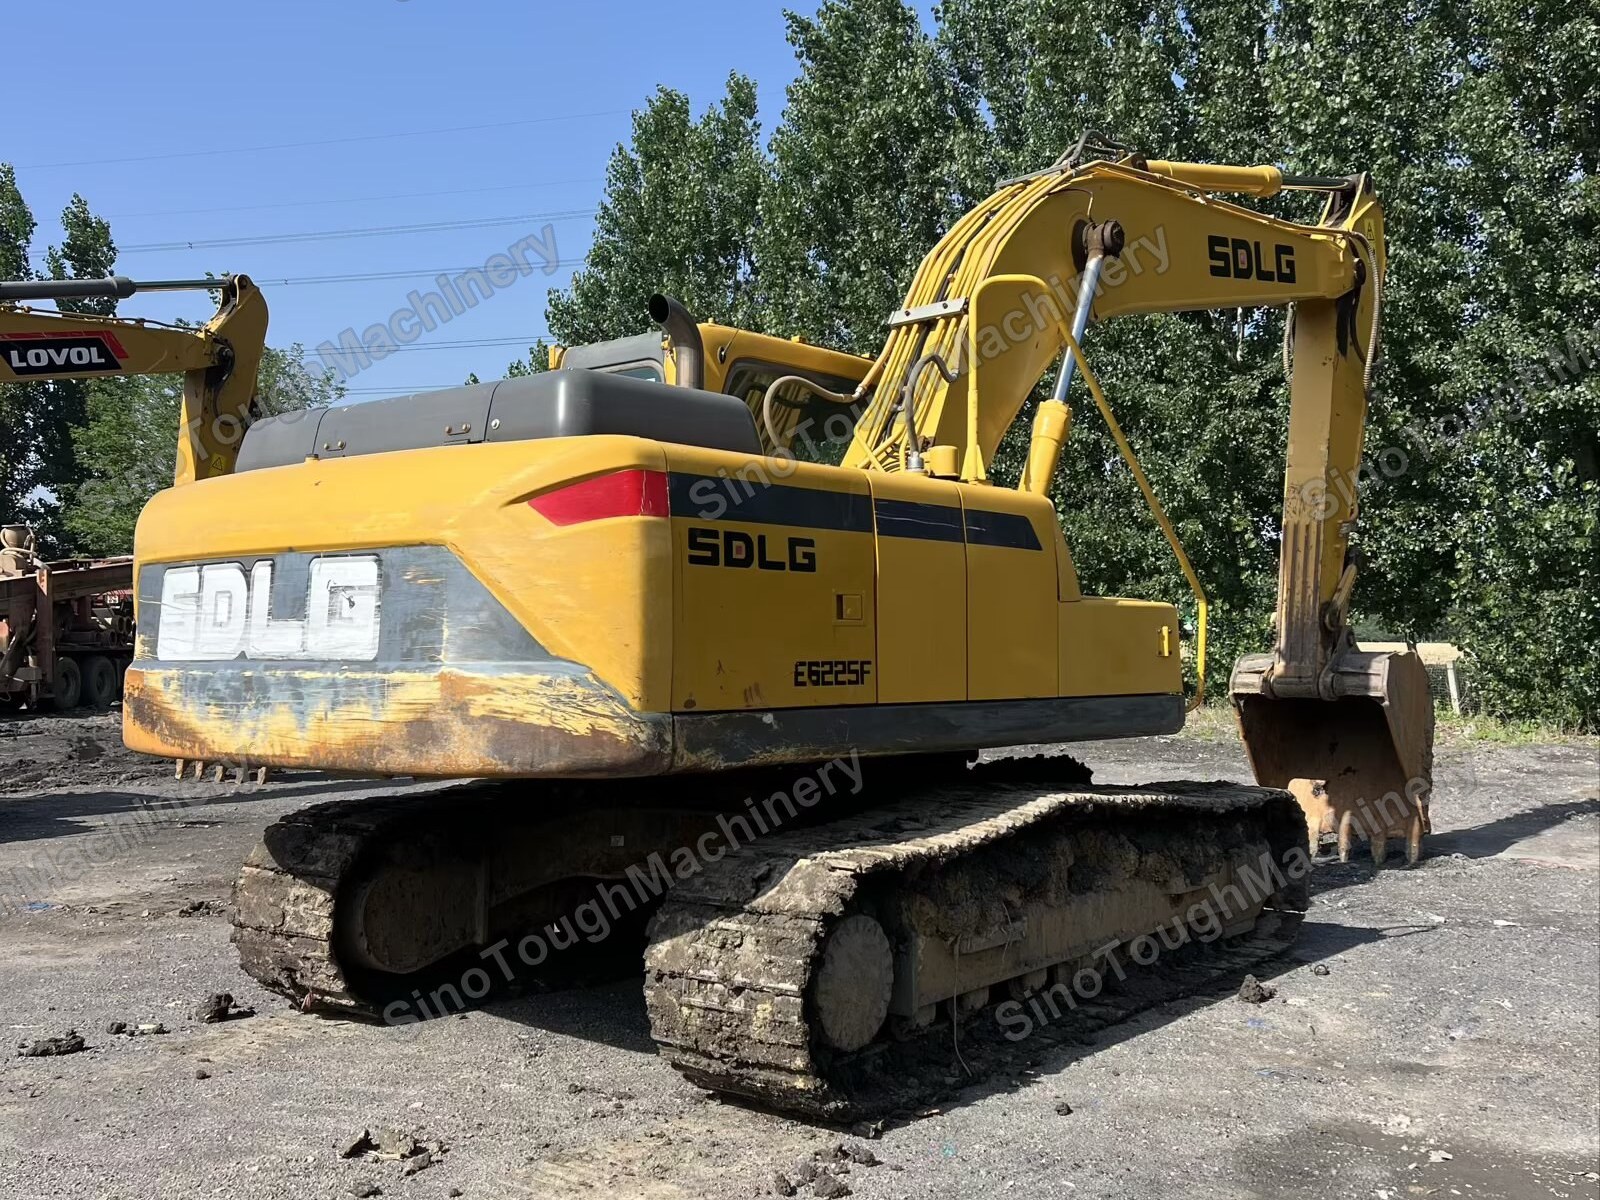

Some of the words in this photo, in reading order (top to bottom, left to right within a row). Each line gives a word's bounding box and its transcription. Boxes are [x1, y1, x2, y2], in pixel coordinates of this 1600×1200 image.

[1208, 235, 1296, 283] SDLG
[10, 347, 105, 367] LOVOL
[688, 527, 816, 572] SDLG
[157, 555, 380, 661] SDLG
[794, 661, 872, 687] E6225F
